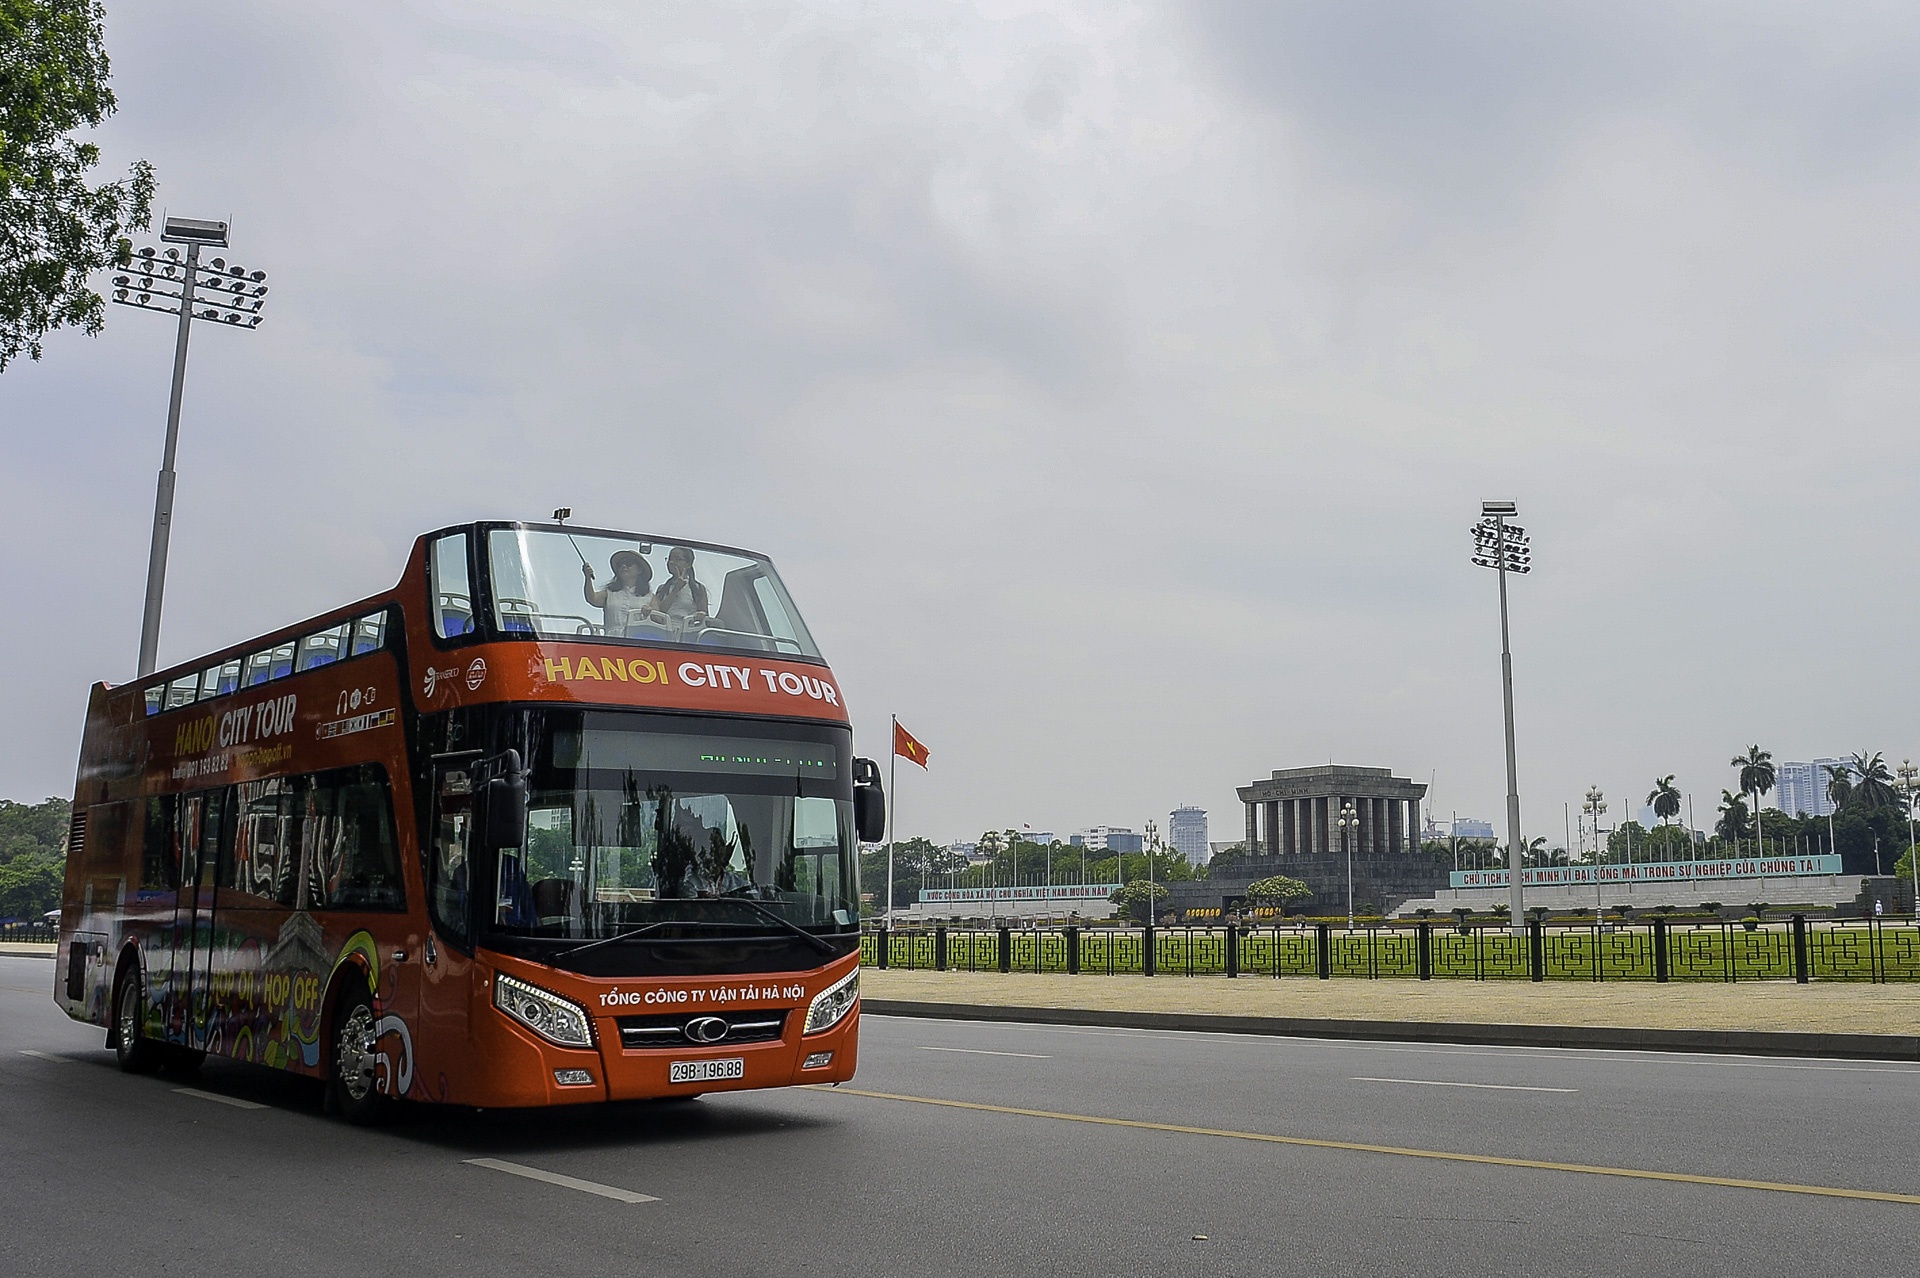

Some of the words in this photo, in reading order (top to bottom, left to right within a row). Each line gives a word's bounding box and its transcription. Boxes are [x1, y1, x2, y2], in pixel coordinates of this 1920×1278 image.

[544, 656, 669, 685] HANOI
[676, 661, 752, 690] CITY
[759, 669, 840, 707] TOUR
[174, 716, 217, 757] HANOI
[219, 706, 254, 748] CITY
[255, 693, 297, 740] TOUR
[1463, 871, 1480, 885] CHỦ
[1483, 873, 1501, 886] TỊCH
[1536, 870, 1559, 882] MINH
[1575, 869, 1590, 882] ĐẠI
[1643, 865, 1675, 878] TRONG
[1678, 863, 1692, 878] SỰ
[1695, 861, 1731, 878] NGHIỆP
[1735, 858, 1756, 875] CỦA
[1760, 858, 1795, 874] CHÚNG
[1799, 859, 1814, 872] TA
[212, 968, 235, 1005] HOP
[263, 973, 290, 1014] HOP
[294, 976, 319, 1011] OFF
[599, 986, 641, 1007] TỔNG
[644, 987, 688, 1005] CÔNG
[690, 989, 706, 1002] TY
[709, 985, 737, 1005] VẬN
[740, 984, 759, 1000] TẢI
[762, 984, 780, 999] HÀ
[782, 983, 805, 1001] NỘI
[671, 1060, 742, 1081] 29B-196.88
